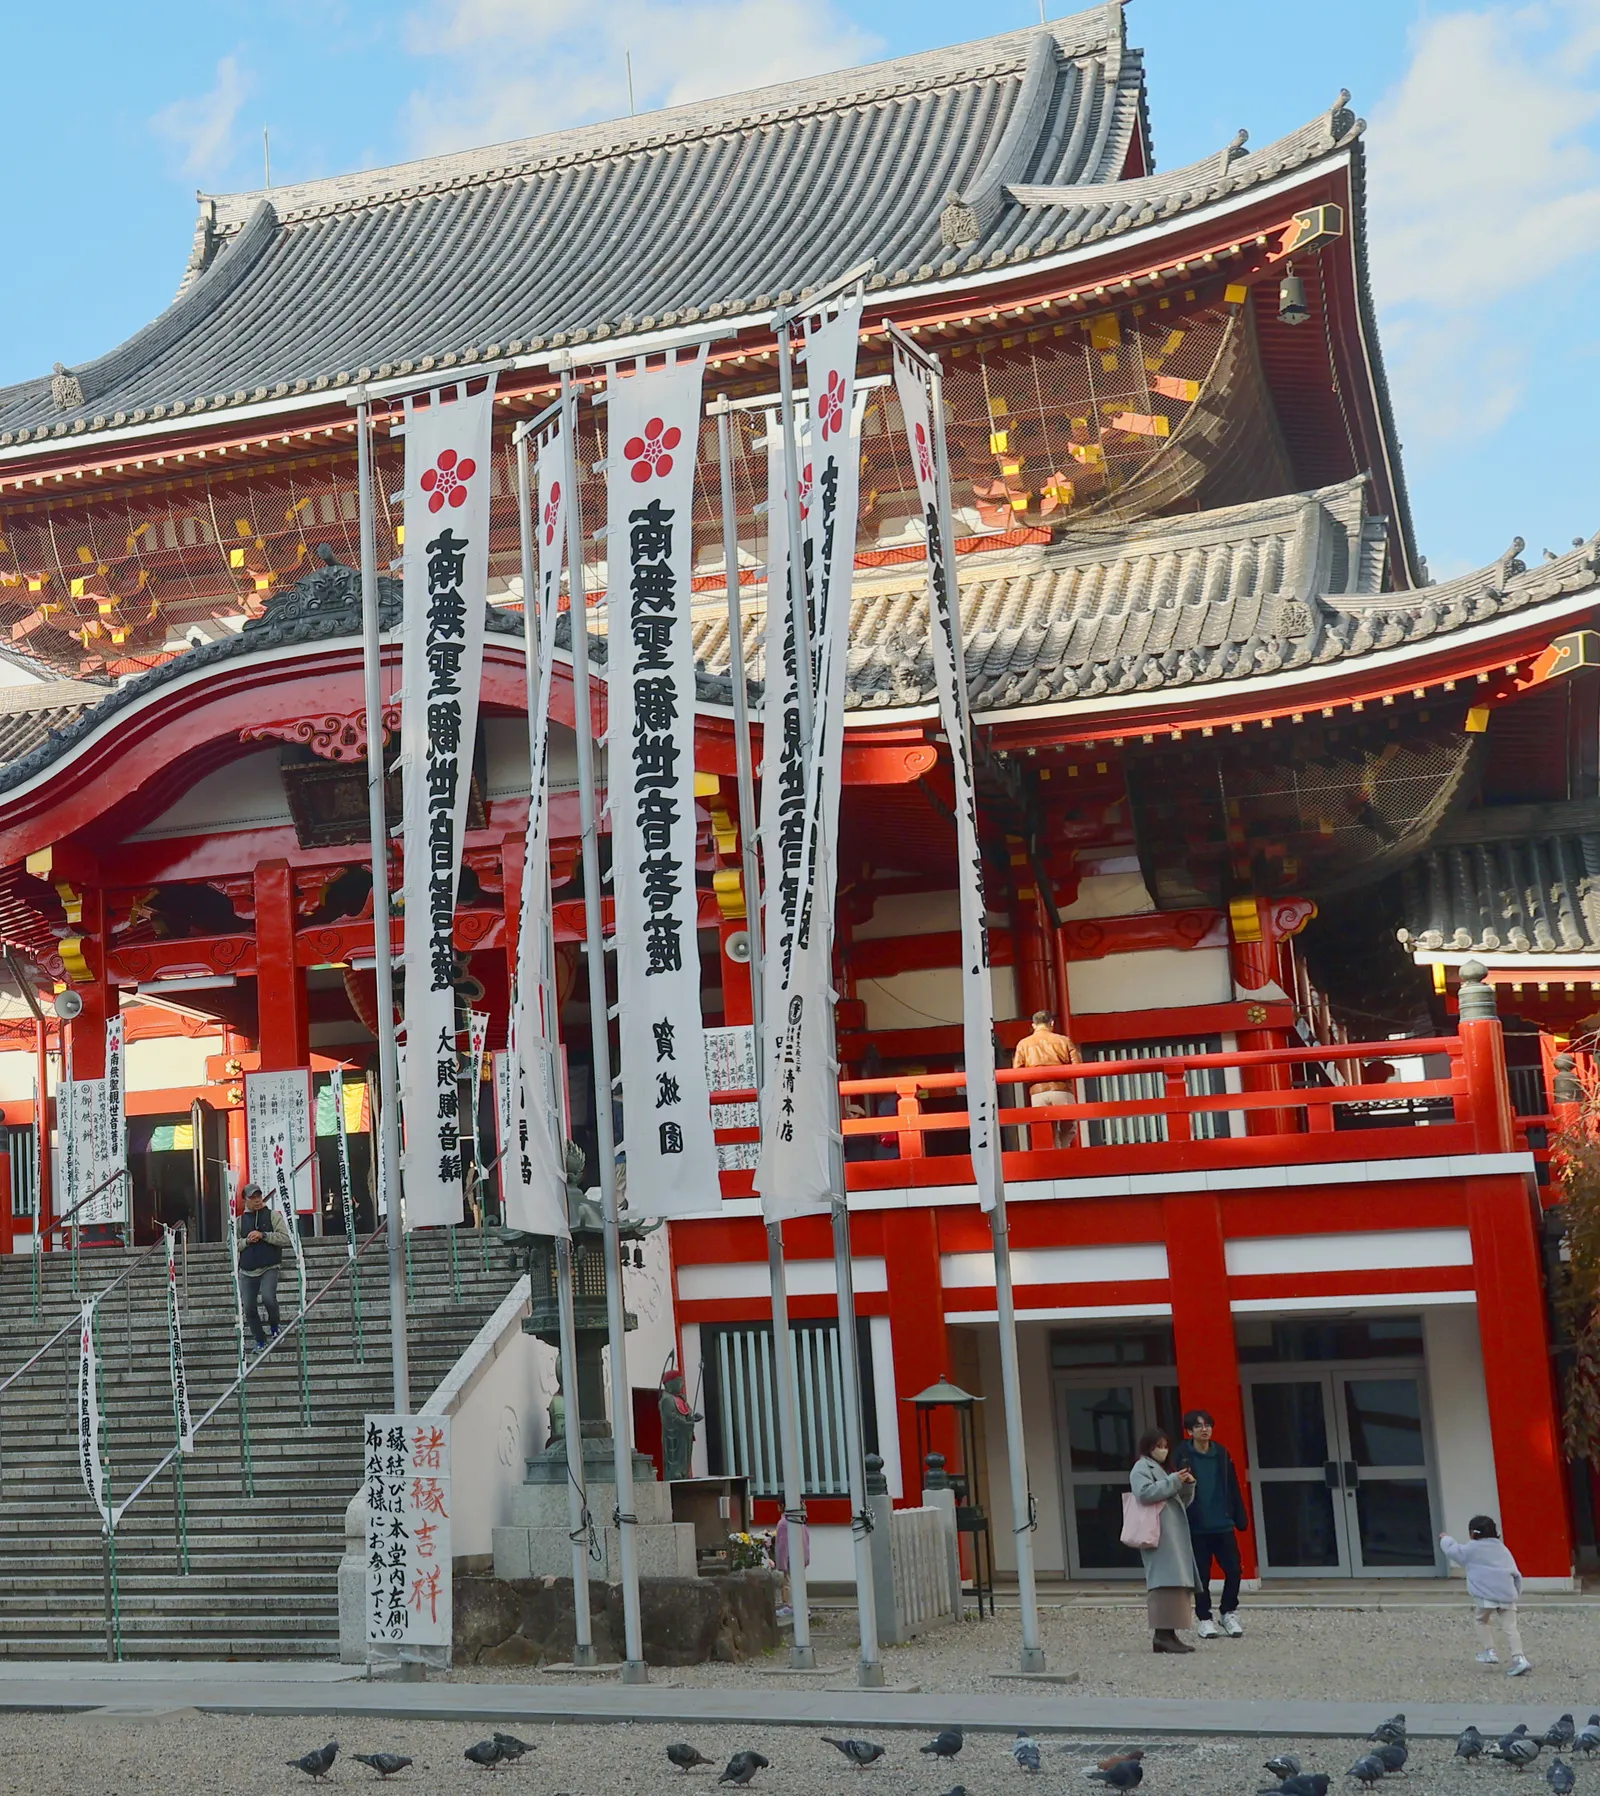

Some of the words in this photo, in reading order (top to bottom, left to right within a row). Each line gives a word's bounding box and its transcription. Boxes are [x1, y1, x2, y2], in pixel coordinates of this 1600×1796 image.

[386, 1427, 409, 1641] 縁結びは本堂内左側の
[408, 1424, 449, 1624] 諸縁吉祥
